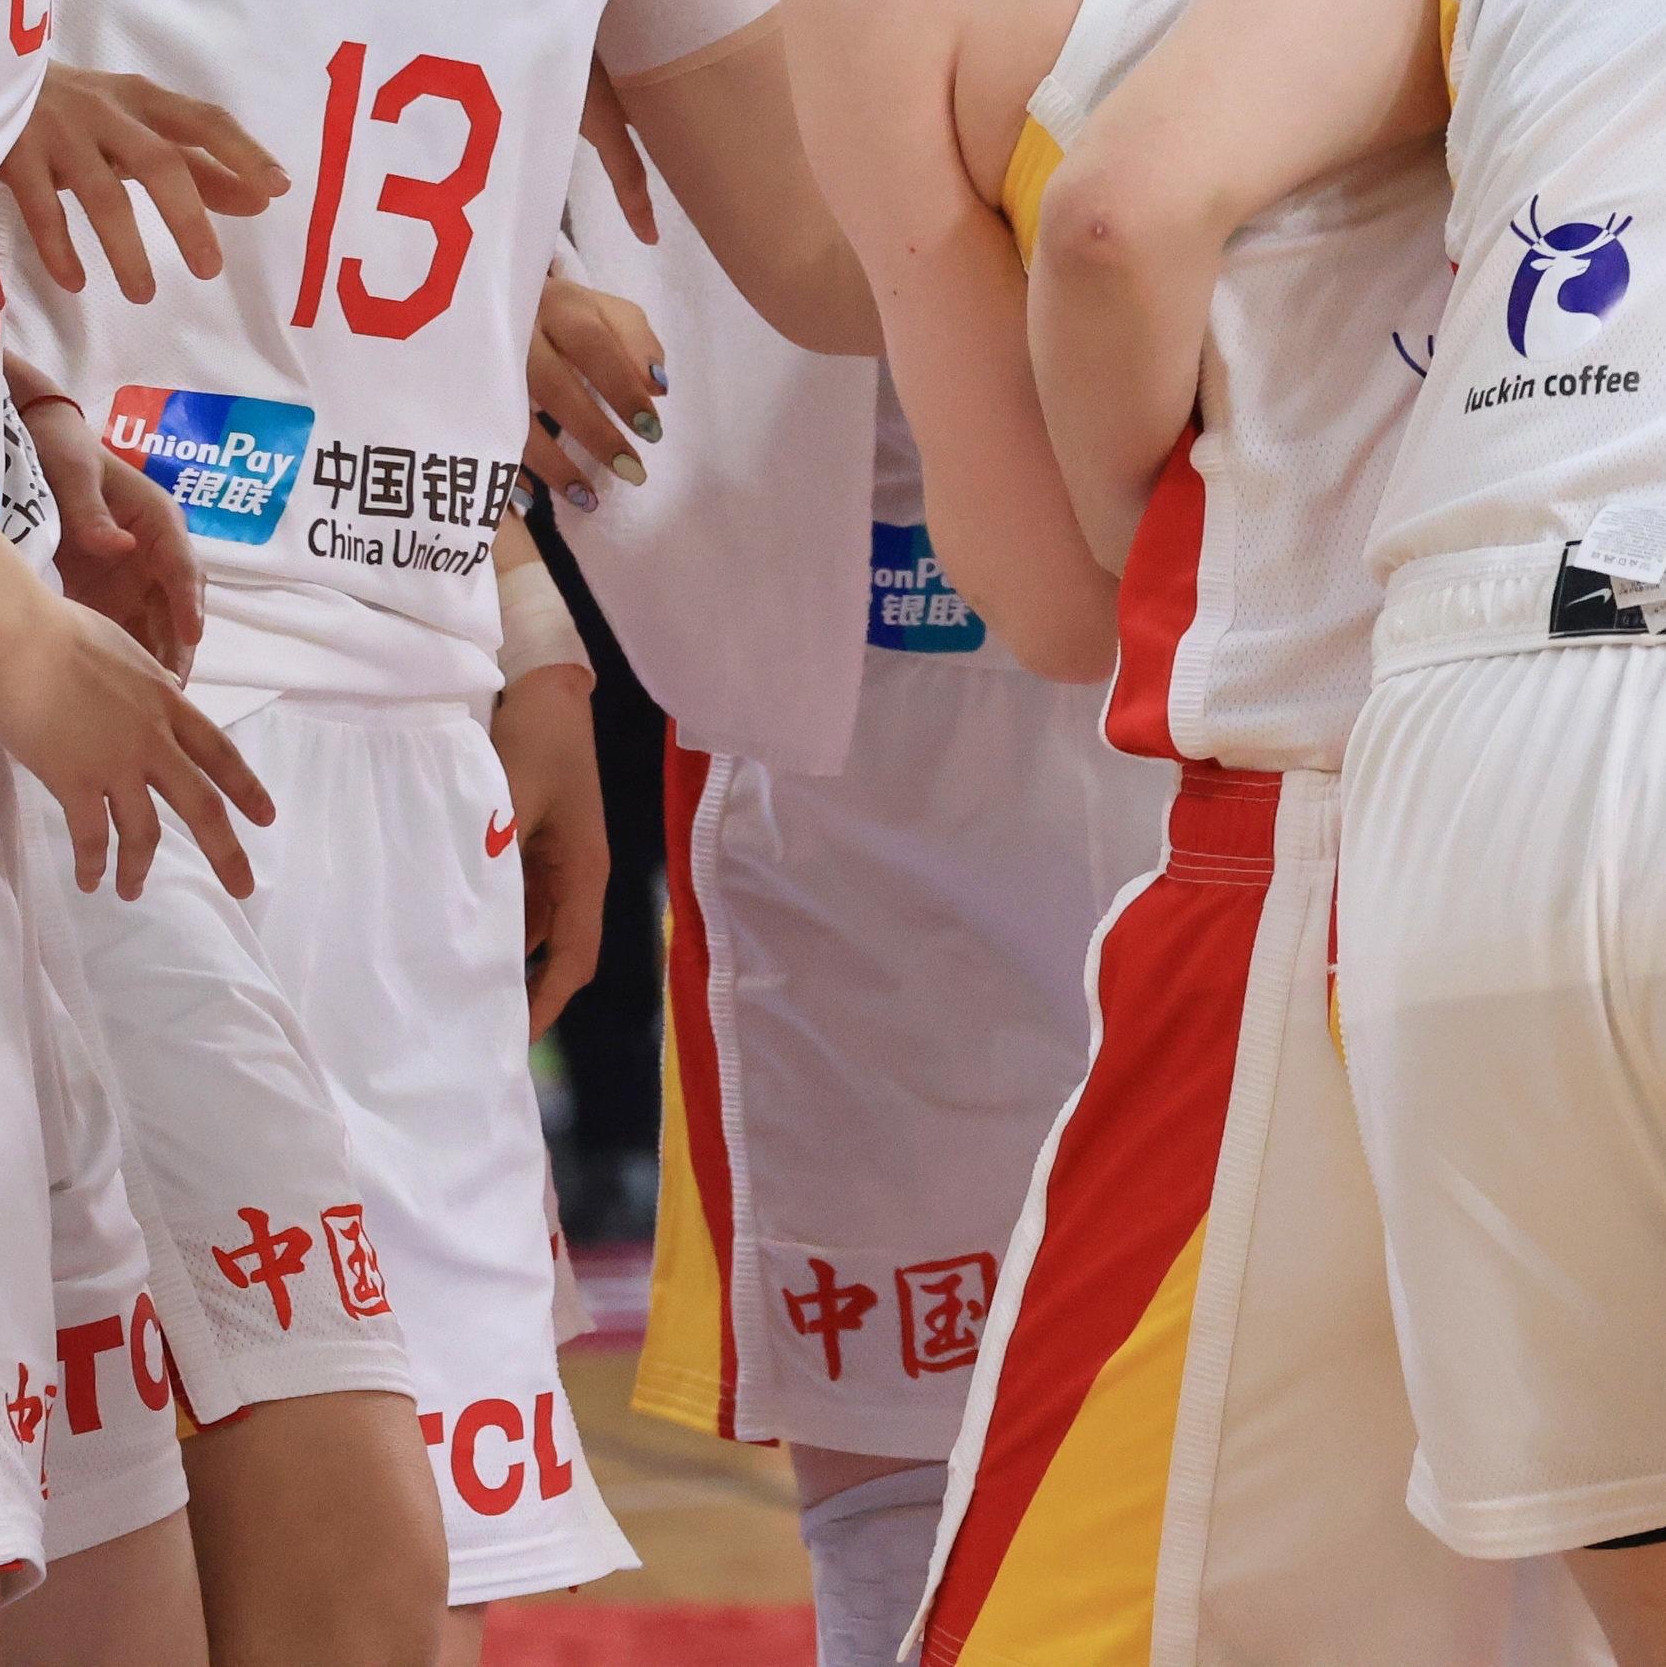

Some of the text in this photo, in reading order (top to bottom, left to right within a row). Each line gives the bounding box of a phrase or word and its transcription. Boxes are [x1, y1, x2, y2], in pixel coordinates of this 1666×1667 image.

[290, 41, 502, 341] 13
[1464, 365, 1640, 414] luckin coffee
[111, 415, 296, 487] UnionPay
[172, 467, 273, 517] 银联
[308, 518, 488, 577] China UnionP
[882, 594, 972, 627] 银联
[212, 1204, 392, 1331] 中国
[782, 1250, 998, 1382] 中国
[56, 1292, 171, 1435] TC
